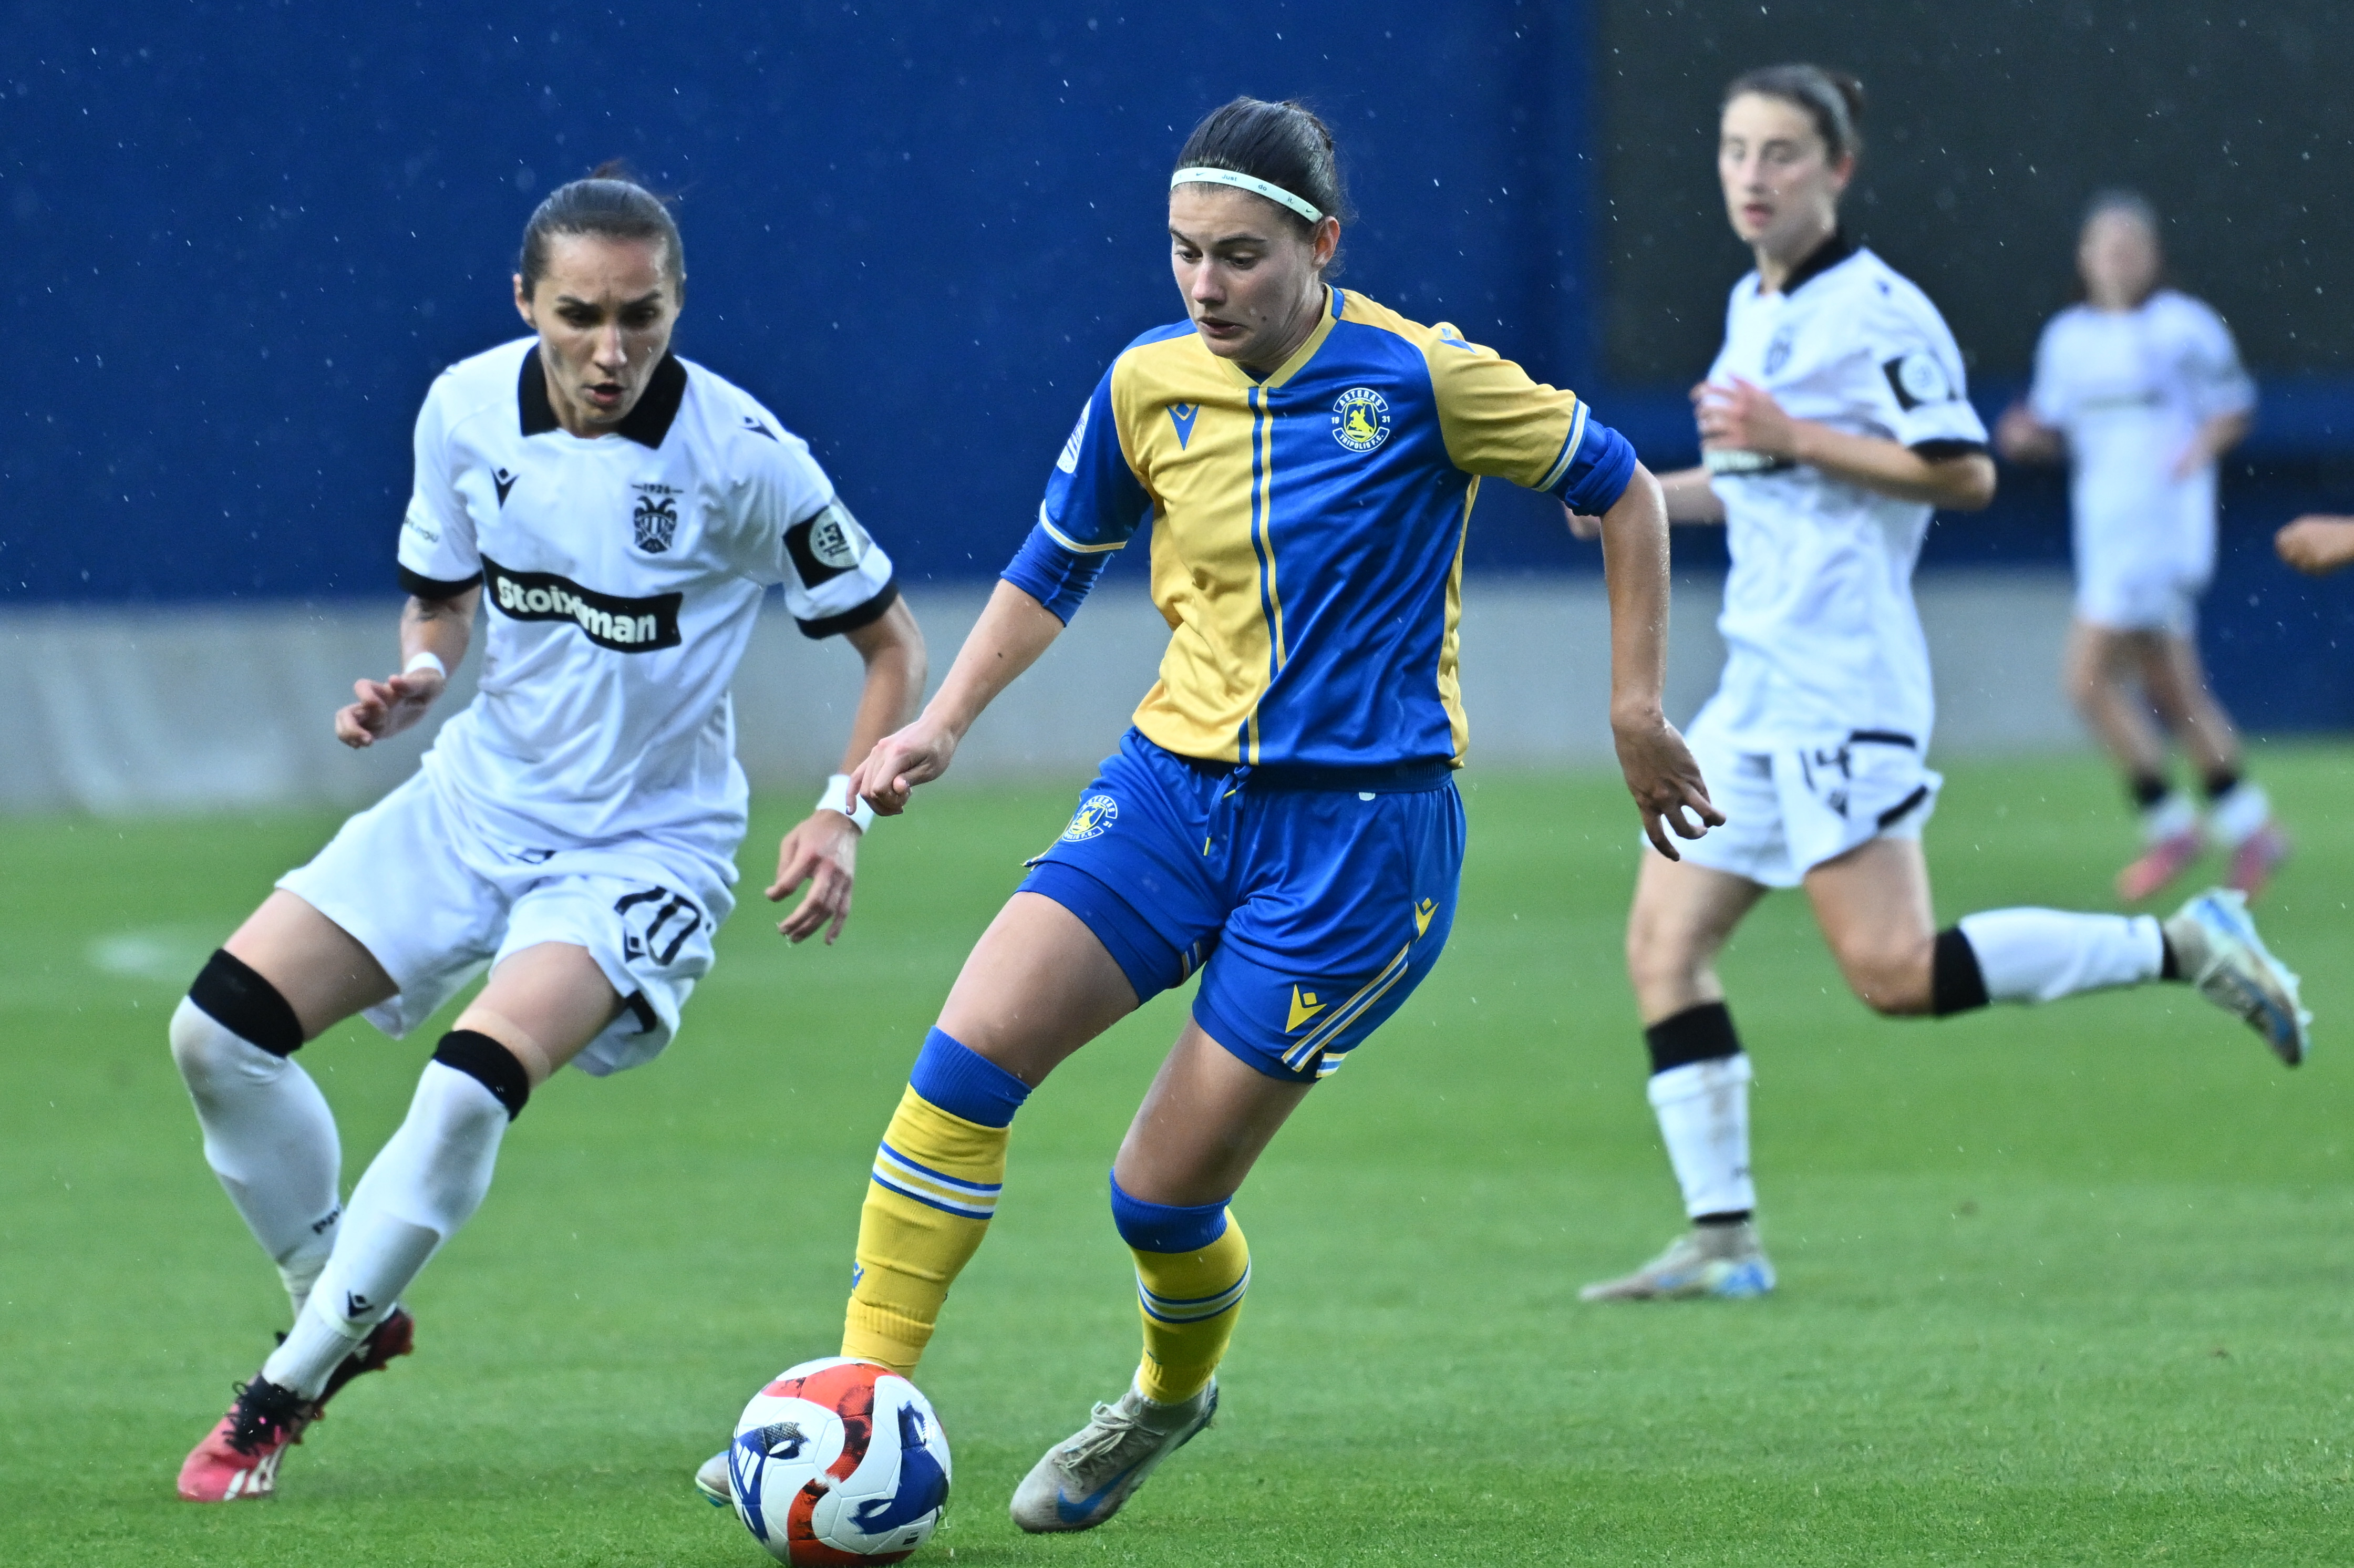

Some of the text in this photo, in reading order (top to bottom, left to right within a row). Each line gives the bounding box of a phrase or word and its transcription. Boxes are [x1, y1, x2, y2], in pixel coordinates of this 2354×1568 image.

[1339, 390, 1382, 407] ASTERAS
[1339, 434, 1384, 450] TRIPOLIS F.C.
